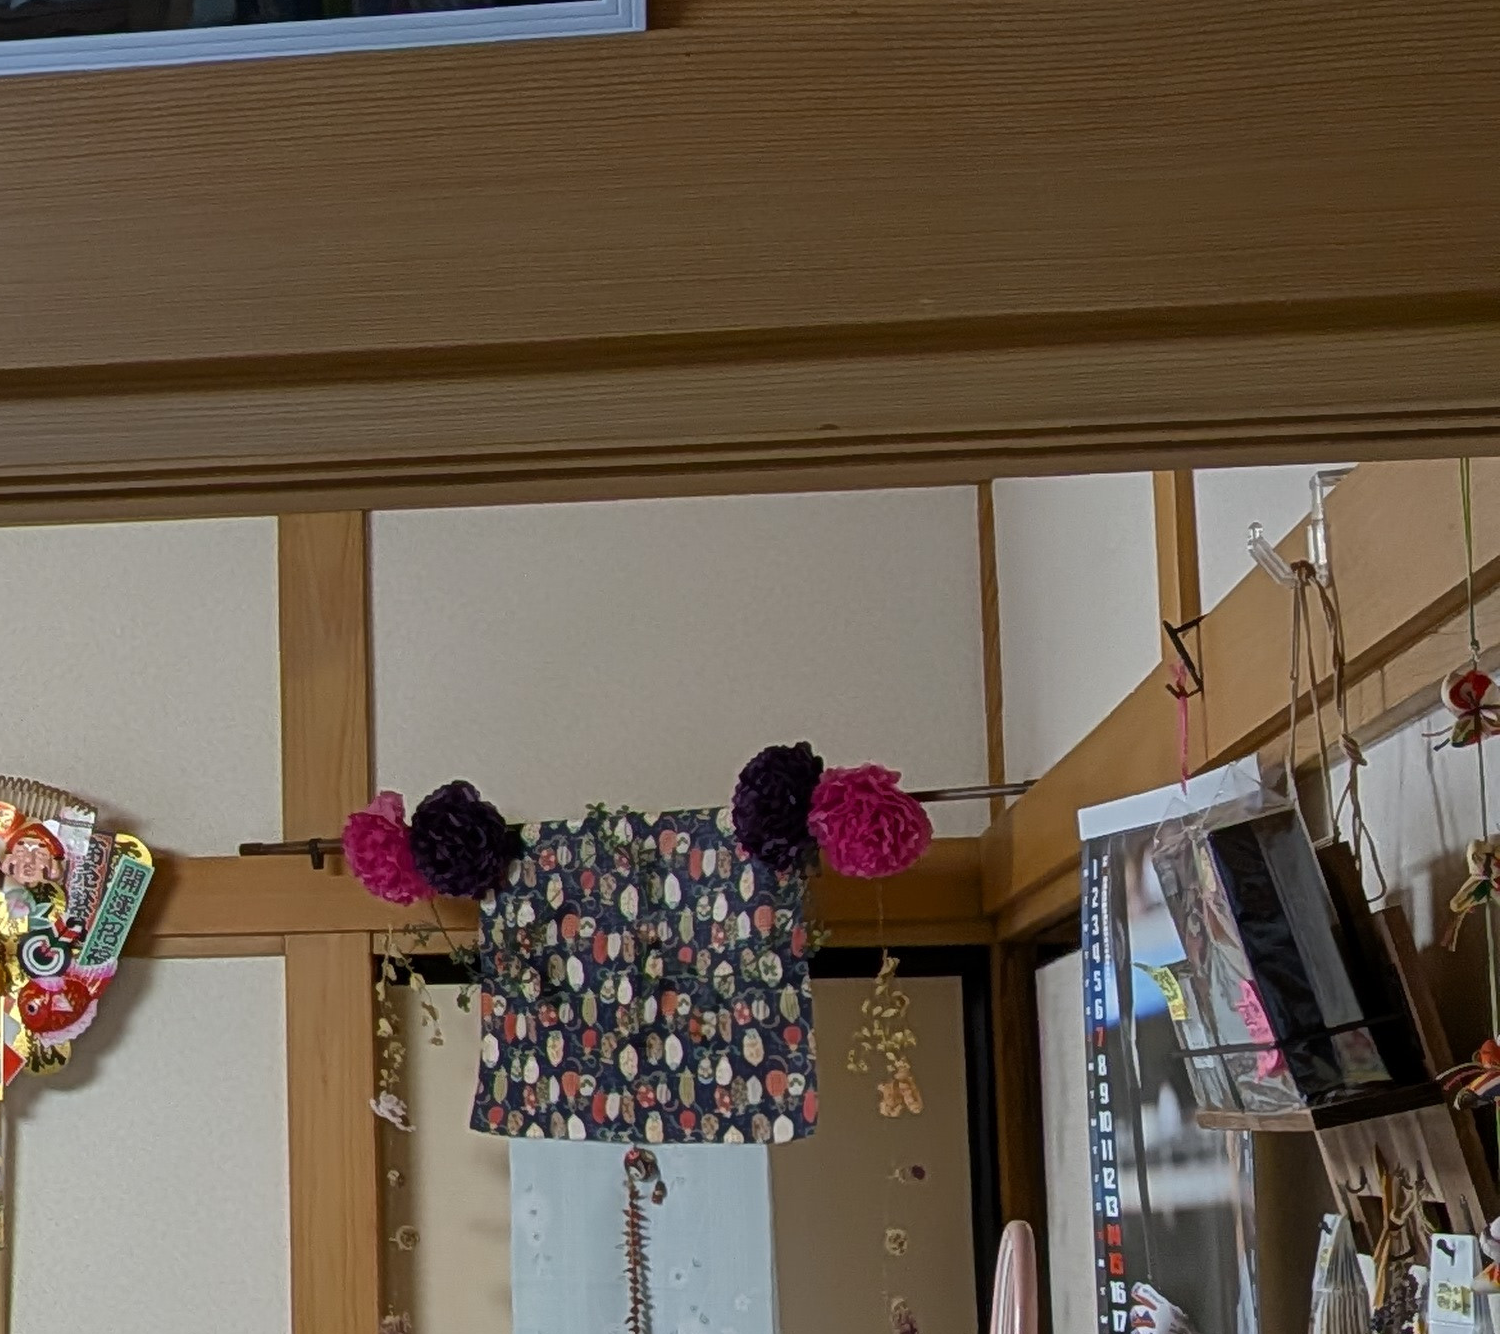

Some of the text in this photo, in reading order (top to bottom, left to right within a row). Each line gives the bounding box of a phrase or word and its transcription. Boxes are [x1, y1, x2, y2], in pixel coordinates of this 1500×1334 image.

[1092, 859, 1098, 880] 1
[1091, 886, 1099, 908] 2
[1091, 913, 1100, 936] 3
[1092, 942, 1100, 964] 4
[1093, 970, 1102, 992] 5
[1094, 998, 1103, 1020] 6
[1095, 1026, 1104, 1047] 7
[1097, 1054, 1107, 1076] 8
[1099, 1082, 1109, 1104] 9
[1099, 1110, 1112, 1133] 10
[1101, 1138, 1114, 1161] 11
[1102, 1167, 1116, 1189] 12
[1104, 1195, 1119, 1217] 13
[1109, 1280, 1127, 1304] 16
[1112, 1309, 1128, 1332] 17
